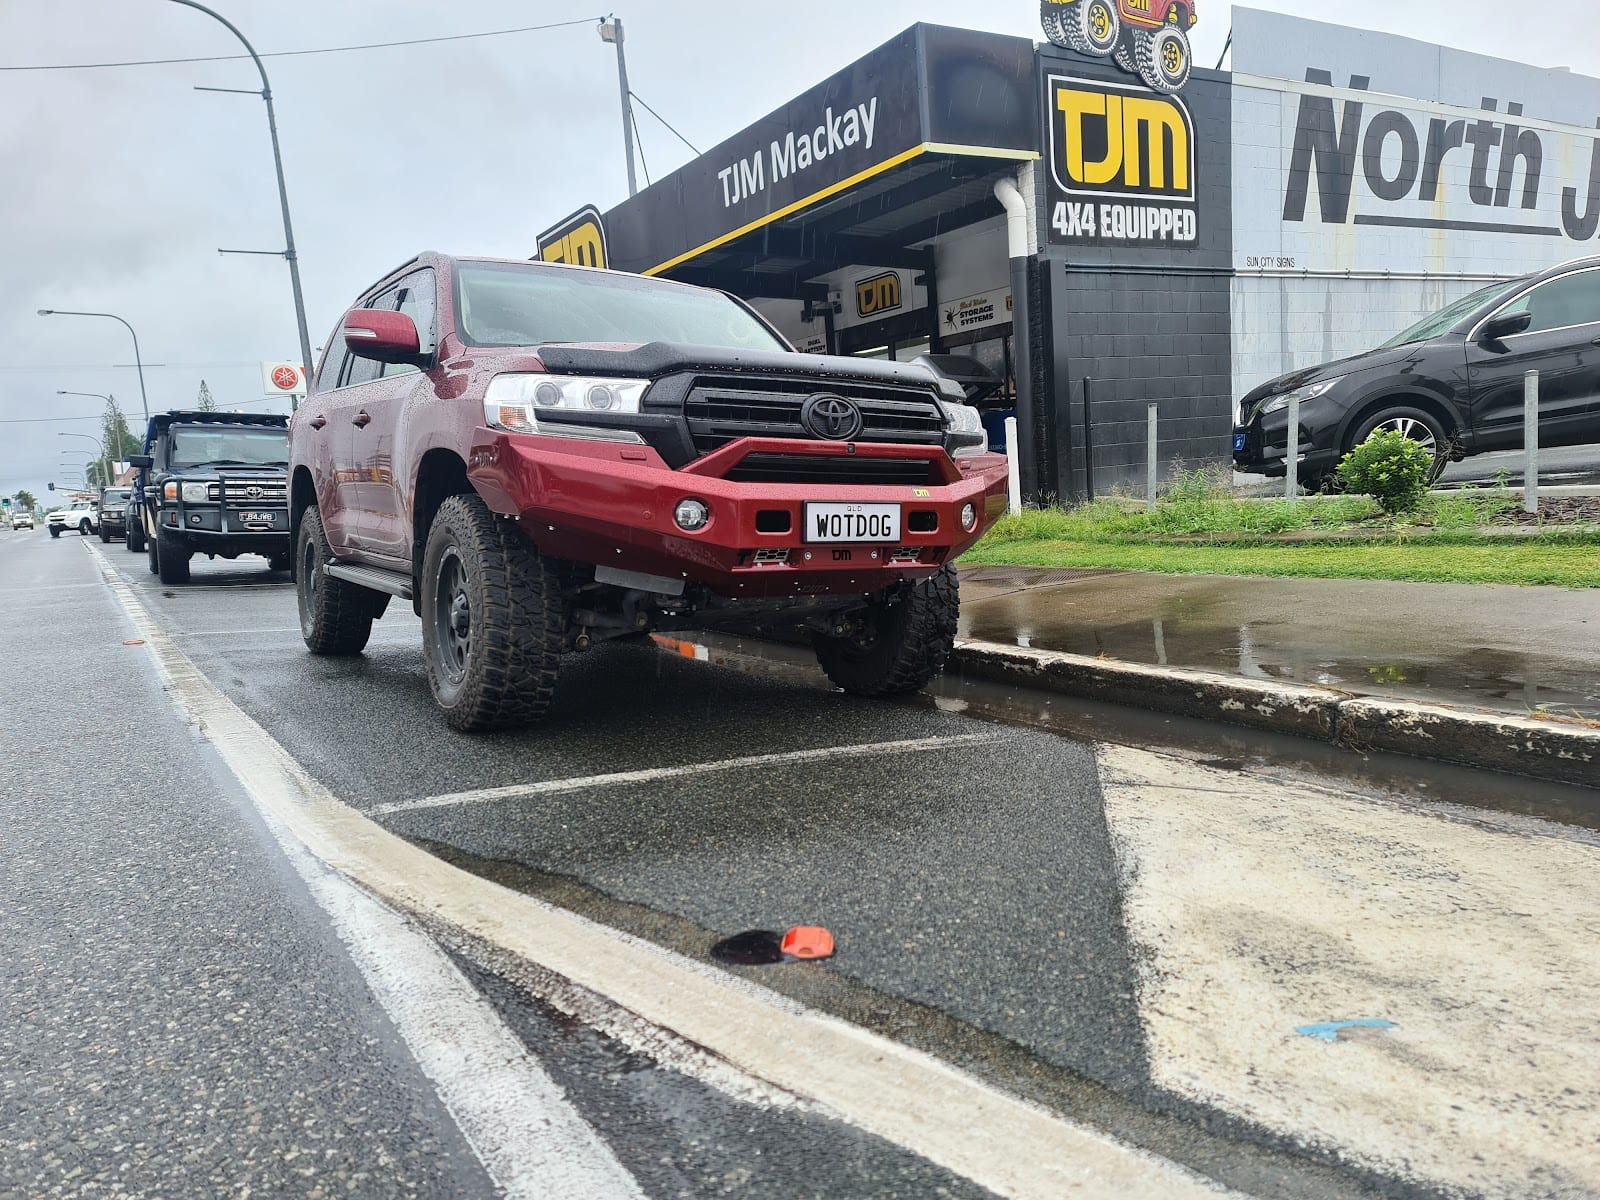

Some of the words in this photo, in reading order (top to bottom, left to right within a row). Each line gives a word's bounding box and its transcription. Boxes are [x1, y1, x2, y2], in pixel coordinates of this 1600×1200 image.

[717, 150, 765, 208] TJM
[770, 96, 877, 183] Mackay
[1056, 88, 1188, 190] TJM
[1282, 67, 1543, 224] North
[1052, 201, 1096, 237] 4X4
[1100, 203, 1196, 241] EQUIPPED
[1246, 256, 1259, 267] SUN
[1260, 256, 1275, 268] CITY
[1276, 256, 1295, 268] SIGNS
[959, 304, 994, 319] STORAGE
[960, 312, 994, 327] SYSTEMS
[816, 513, 892, 537] WOTDOG
